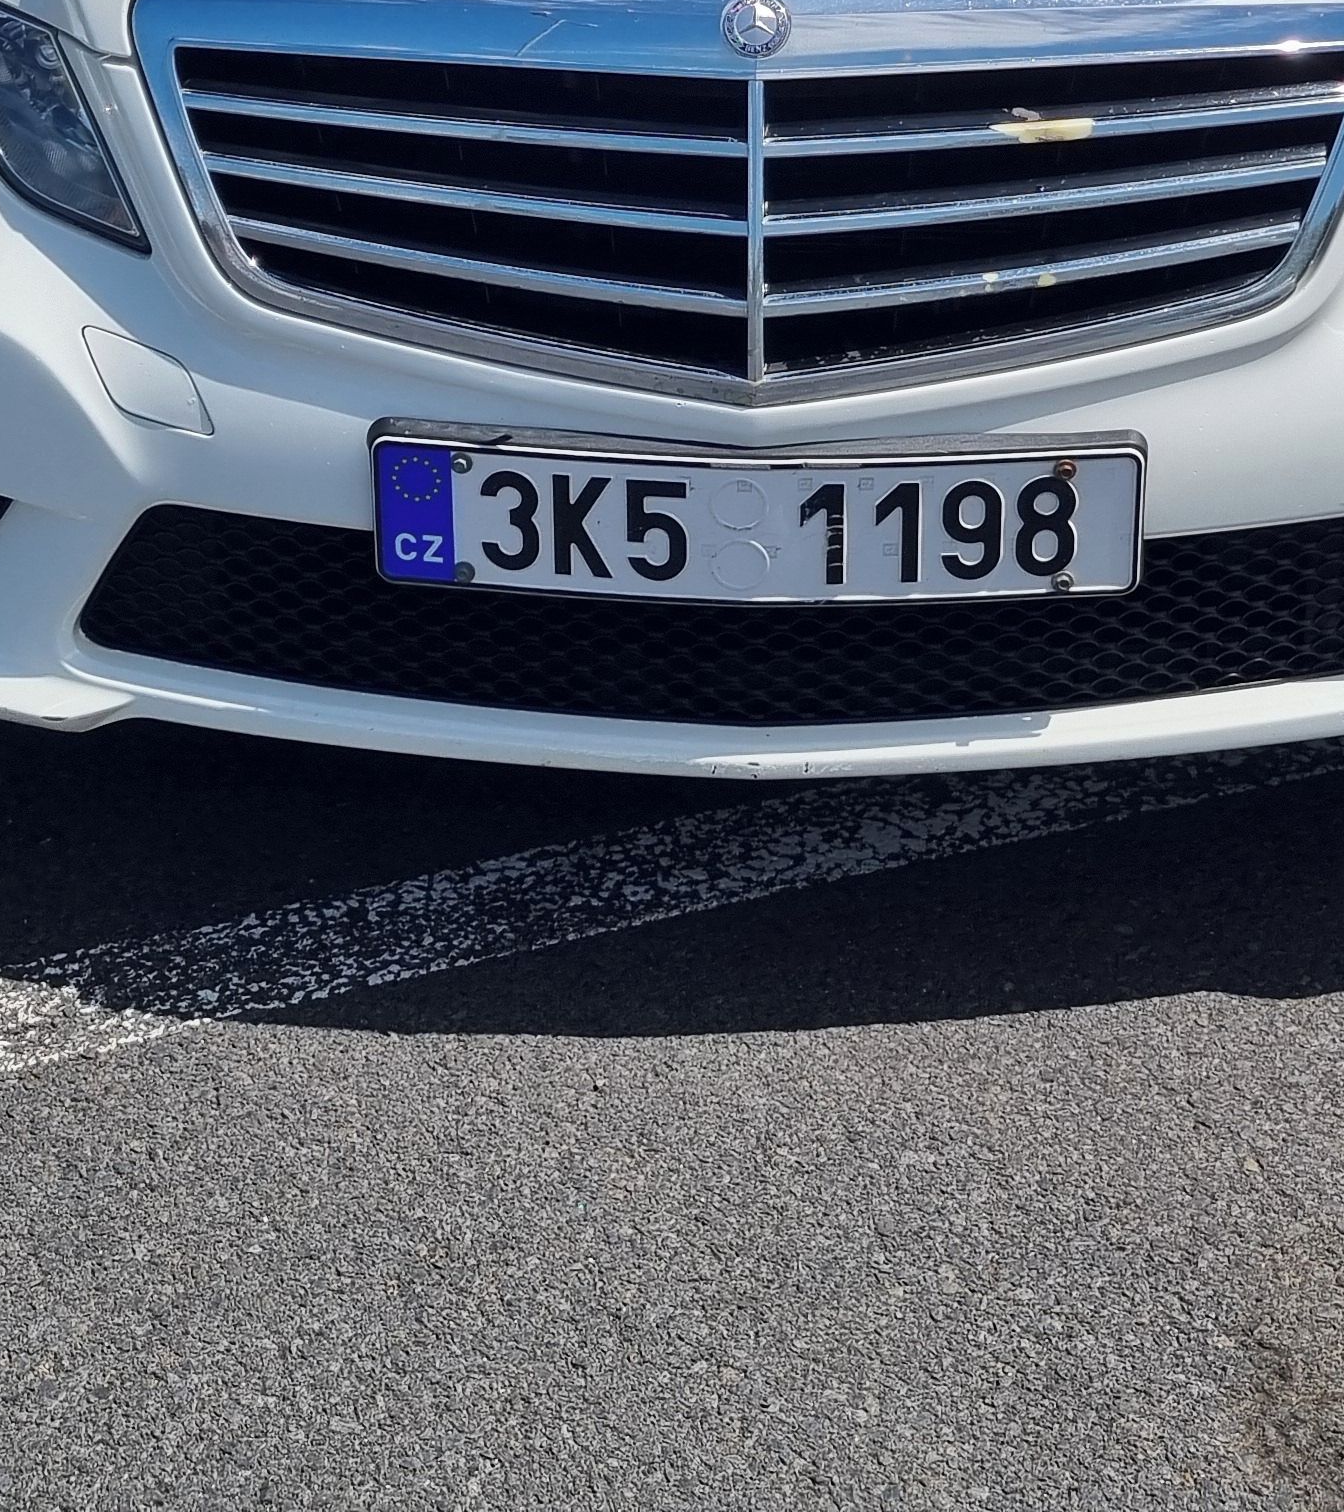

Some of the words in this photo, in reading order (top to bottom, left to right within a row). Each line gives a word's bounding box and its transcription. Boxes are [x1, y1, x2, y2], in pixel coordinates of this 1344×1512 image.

[394, 532, 444, 564] CZ
[479, 470, 687, 582] 3K5
[798, 475, 1079, 585] 1198
